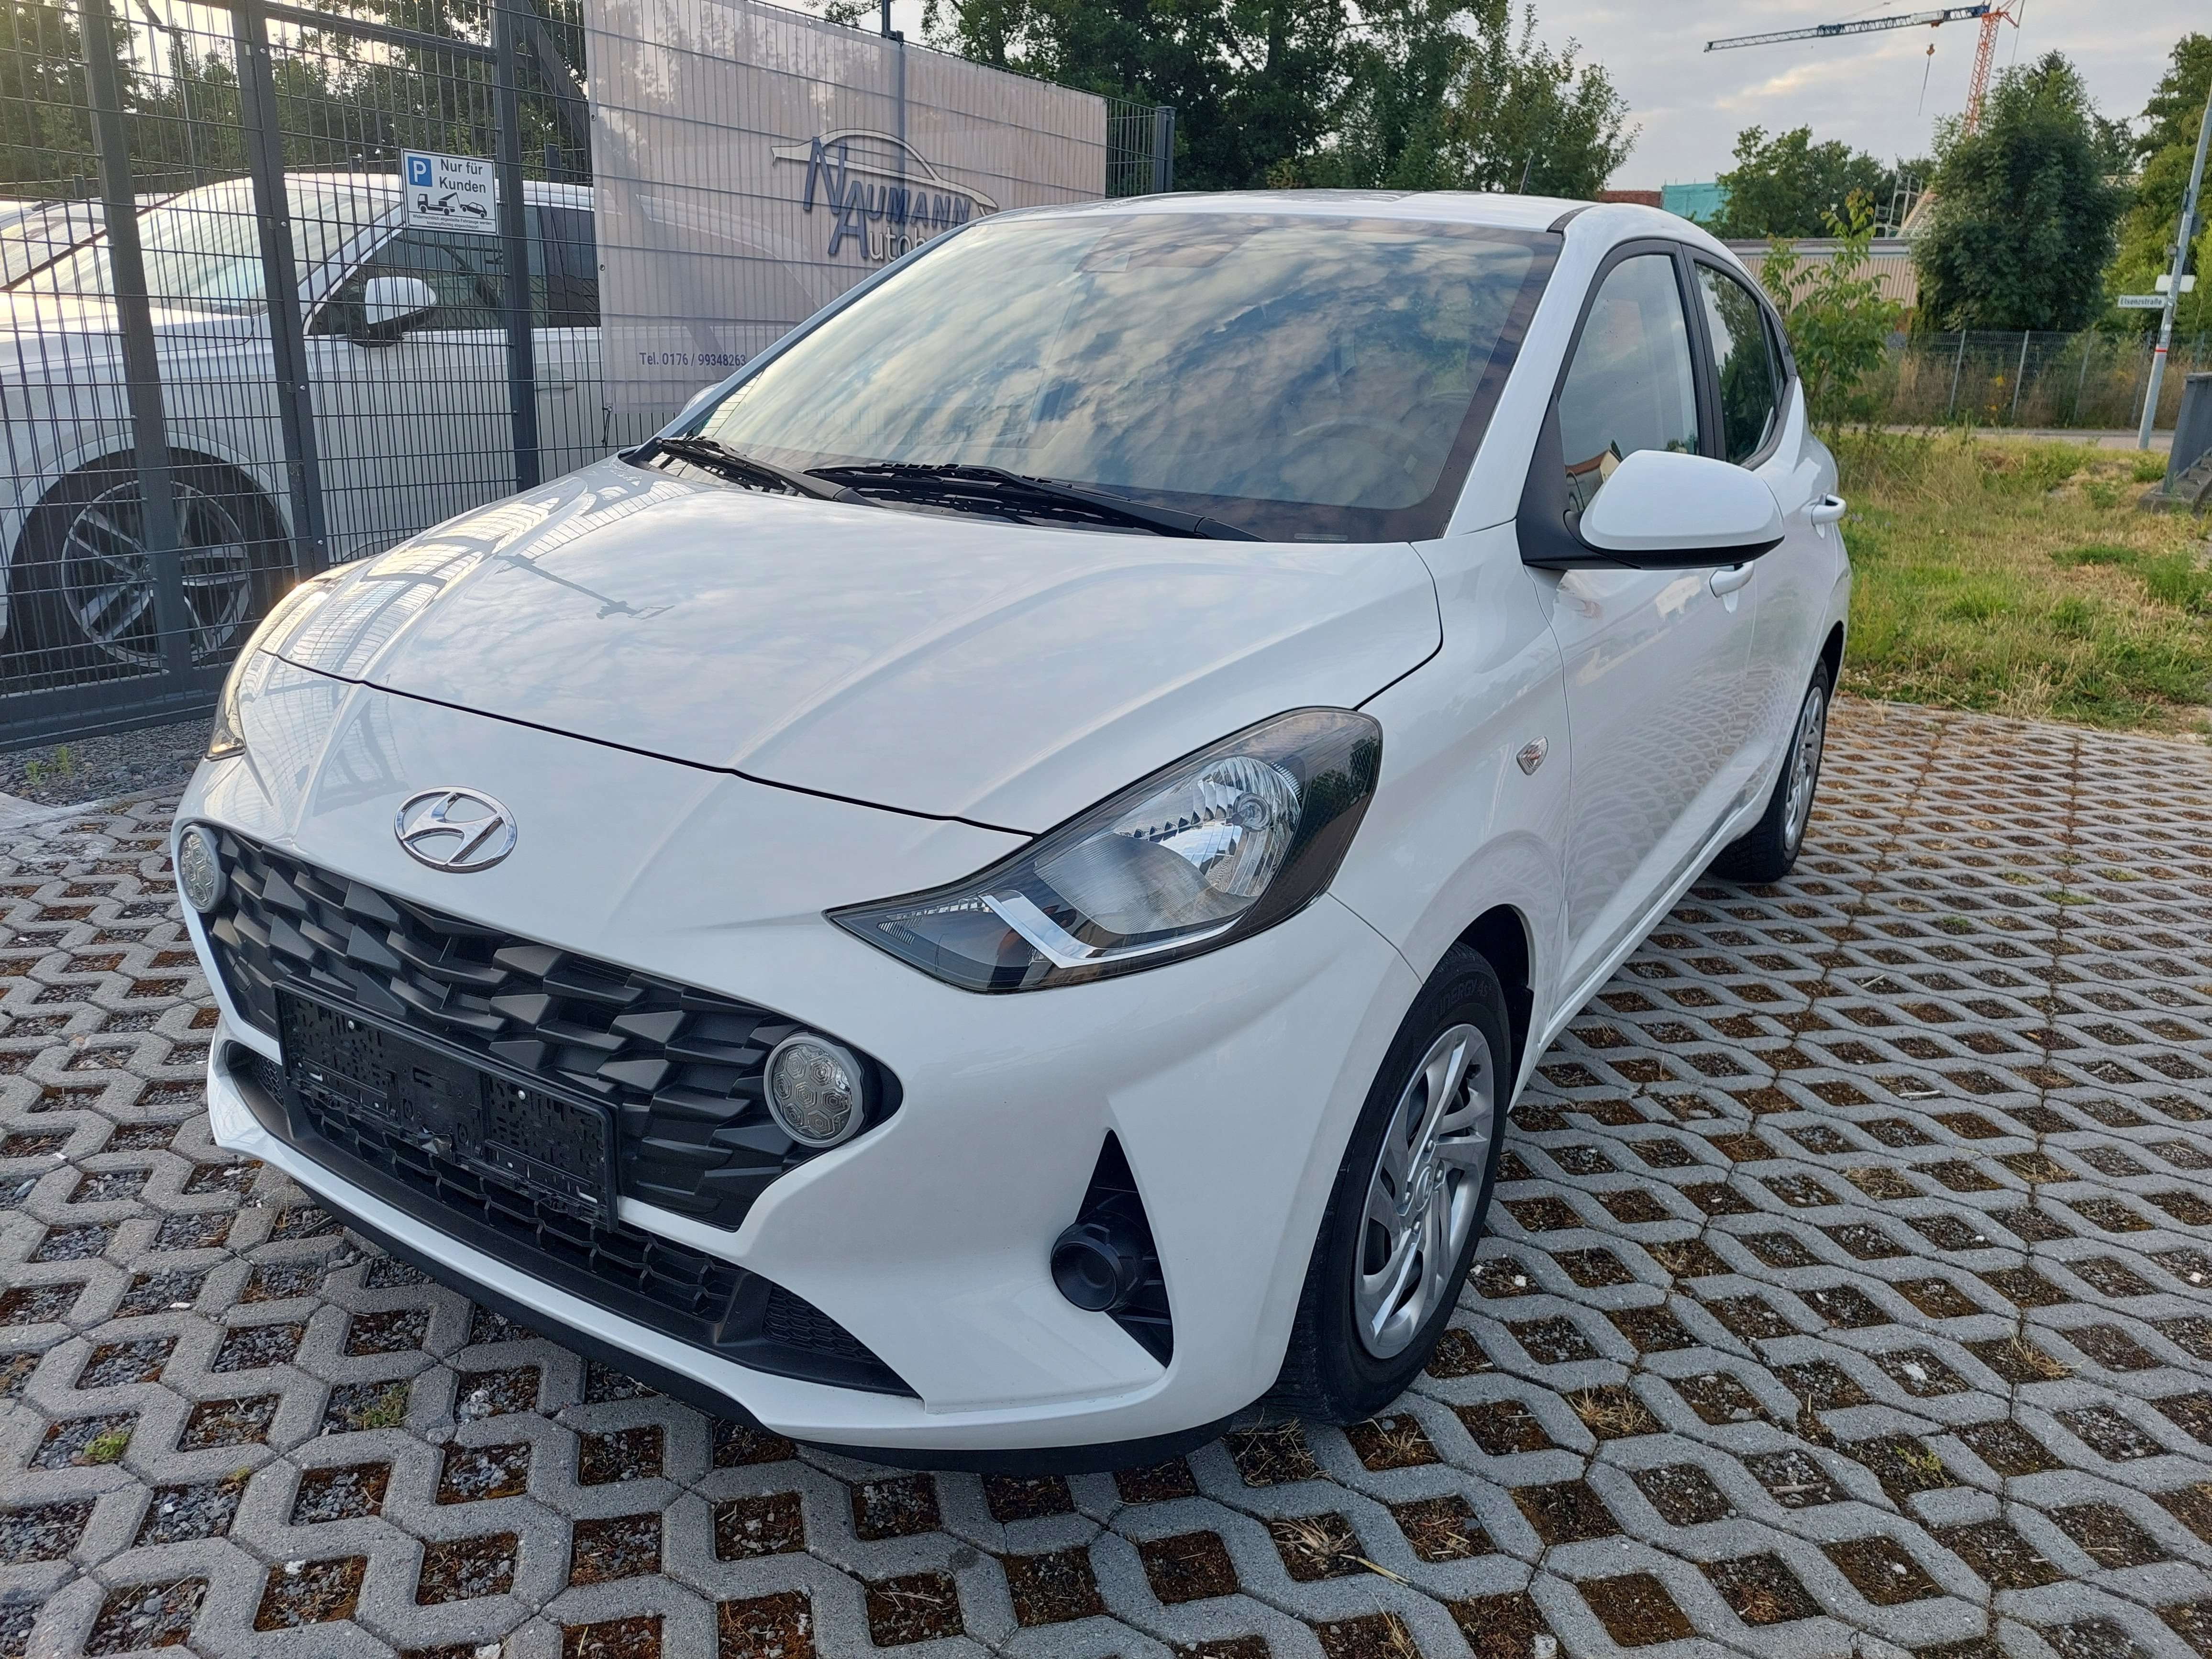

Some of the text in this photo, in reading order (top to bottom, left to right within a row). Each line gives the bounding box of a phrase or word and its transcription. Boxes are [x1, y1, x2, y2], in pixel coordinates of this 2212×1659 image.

[413, 160, 427, 183] P
[440, 158, 483, 176] Nur für
[439, 176, 487, 193] Kunden
[803, 136, 971, 229] NAUMANN
[639, 352, 746, 366] Tel. 0176 / 99348263
